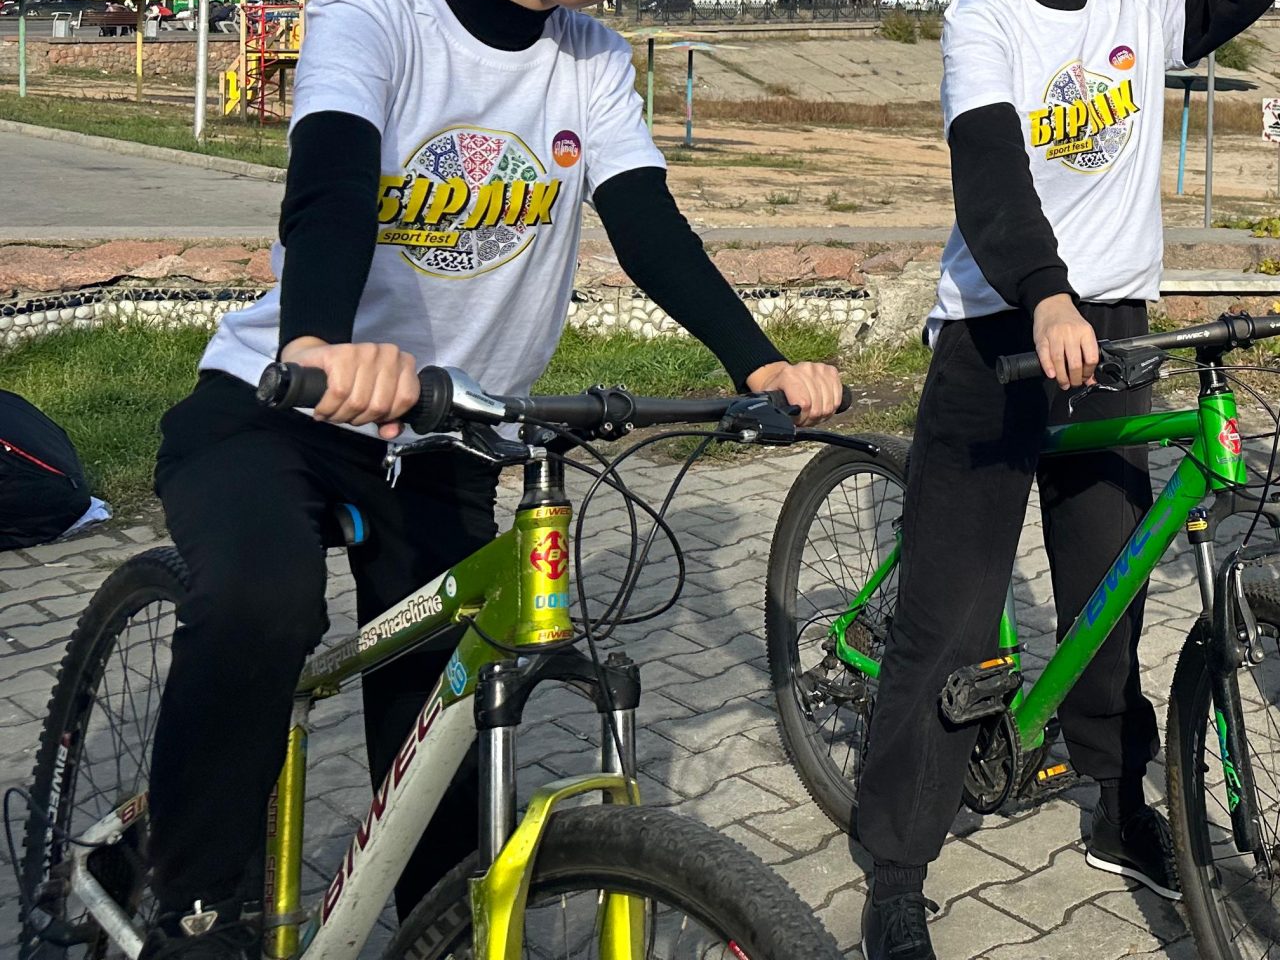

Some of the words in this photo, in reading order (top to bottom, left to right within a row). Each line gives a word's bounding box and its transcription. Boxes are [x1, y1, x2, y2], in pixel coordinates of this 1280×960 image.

[1028, 79, 1141, 147] БІРЛІК
[1048, 144, 1071, 157] sport
[1072, 140, 1089, 151] fest
[383, 231, 421, 243] sport
[424, 231, 451, 244] fest
[49, 746, 69, 823] BIWEC
